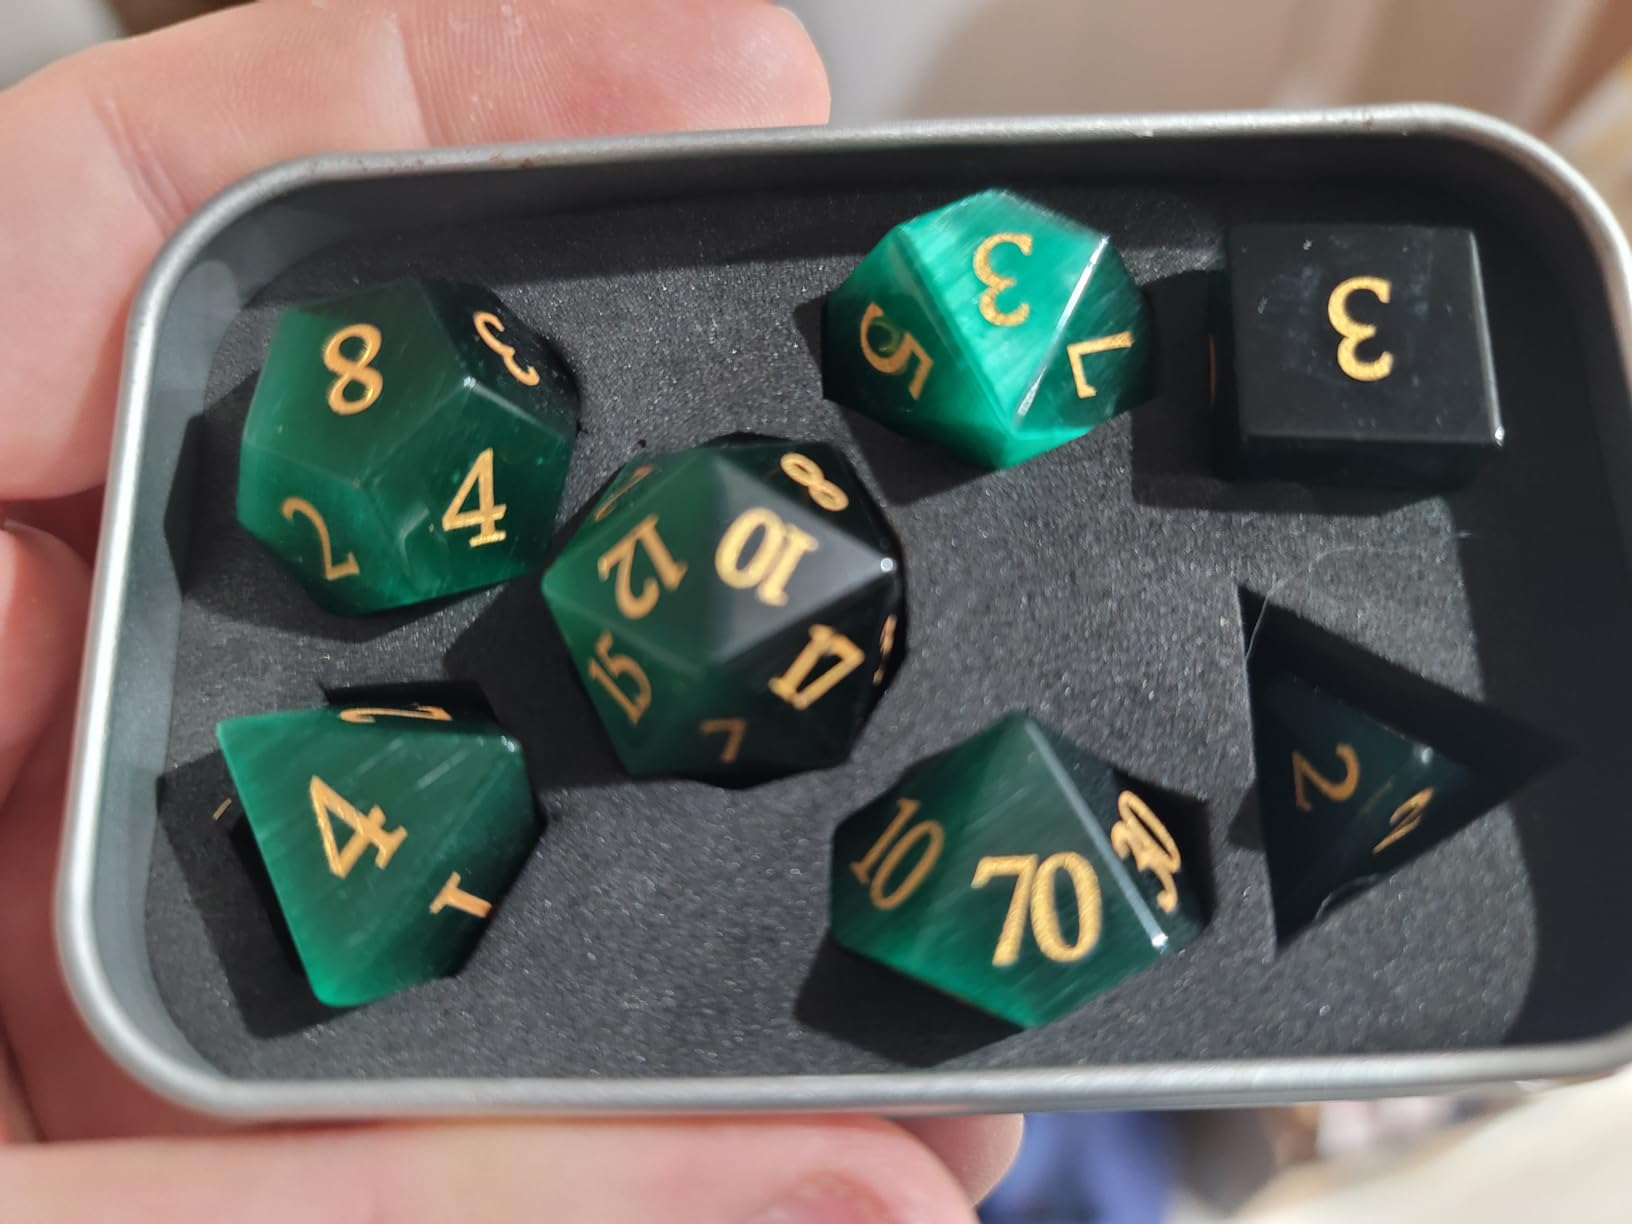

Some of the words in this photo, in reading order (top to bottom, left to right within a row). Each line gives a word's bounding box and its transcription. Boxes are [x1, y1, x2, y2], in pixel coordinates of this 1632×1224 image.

[973, 233, 1033, 327] 3
[1327, 275, 1392, 382] 3
[322, 323, 384, 416] 8
[473, 311, 540, 386] 3
[859, 303, 934, 402] 5
[441, 447, 507, 548] 4
[779, 452, 849, 512] 8
[281, 496, 360, 581] 2
[597, 513, 688, 620] 12
[714, 507, 820, 606] 10
[309, 775, 408, 879] 4
[1291, 743, 1361, 812] 2
[849, 798, 945, 910] 10
[1110, 790, 1182, 913] 30
[971, 851, 1102, 967] 70
